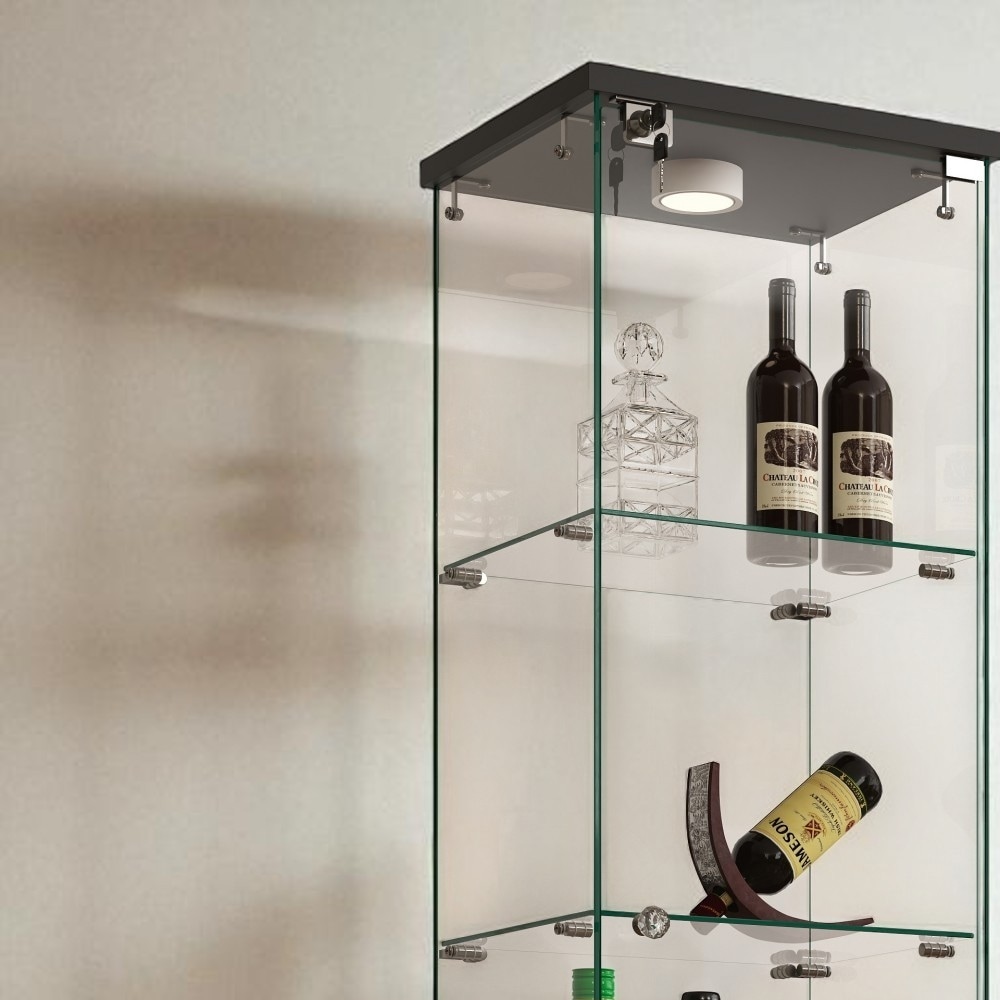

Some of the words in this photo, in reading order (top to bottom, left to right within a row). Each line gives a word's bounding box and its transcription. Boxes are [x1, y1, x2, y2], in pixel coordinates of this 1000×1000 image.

[763, 473, 798, 482] CHATEAU
[800, 474, 808, 483] LA
[838, 482, 873, 491] CHATEAU
[875, 483, 883, 492] LA
